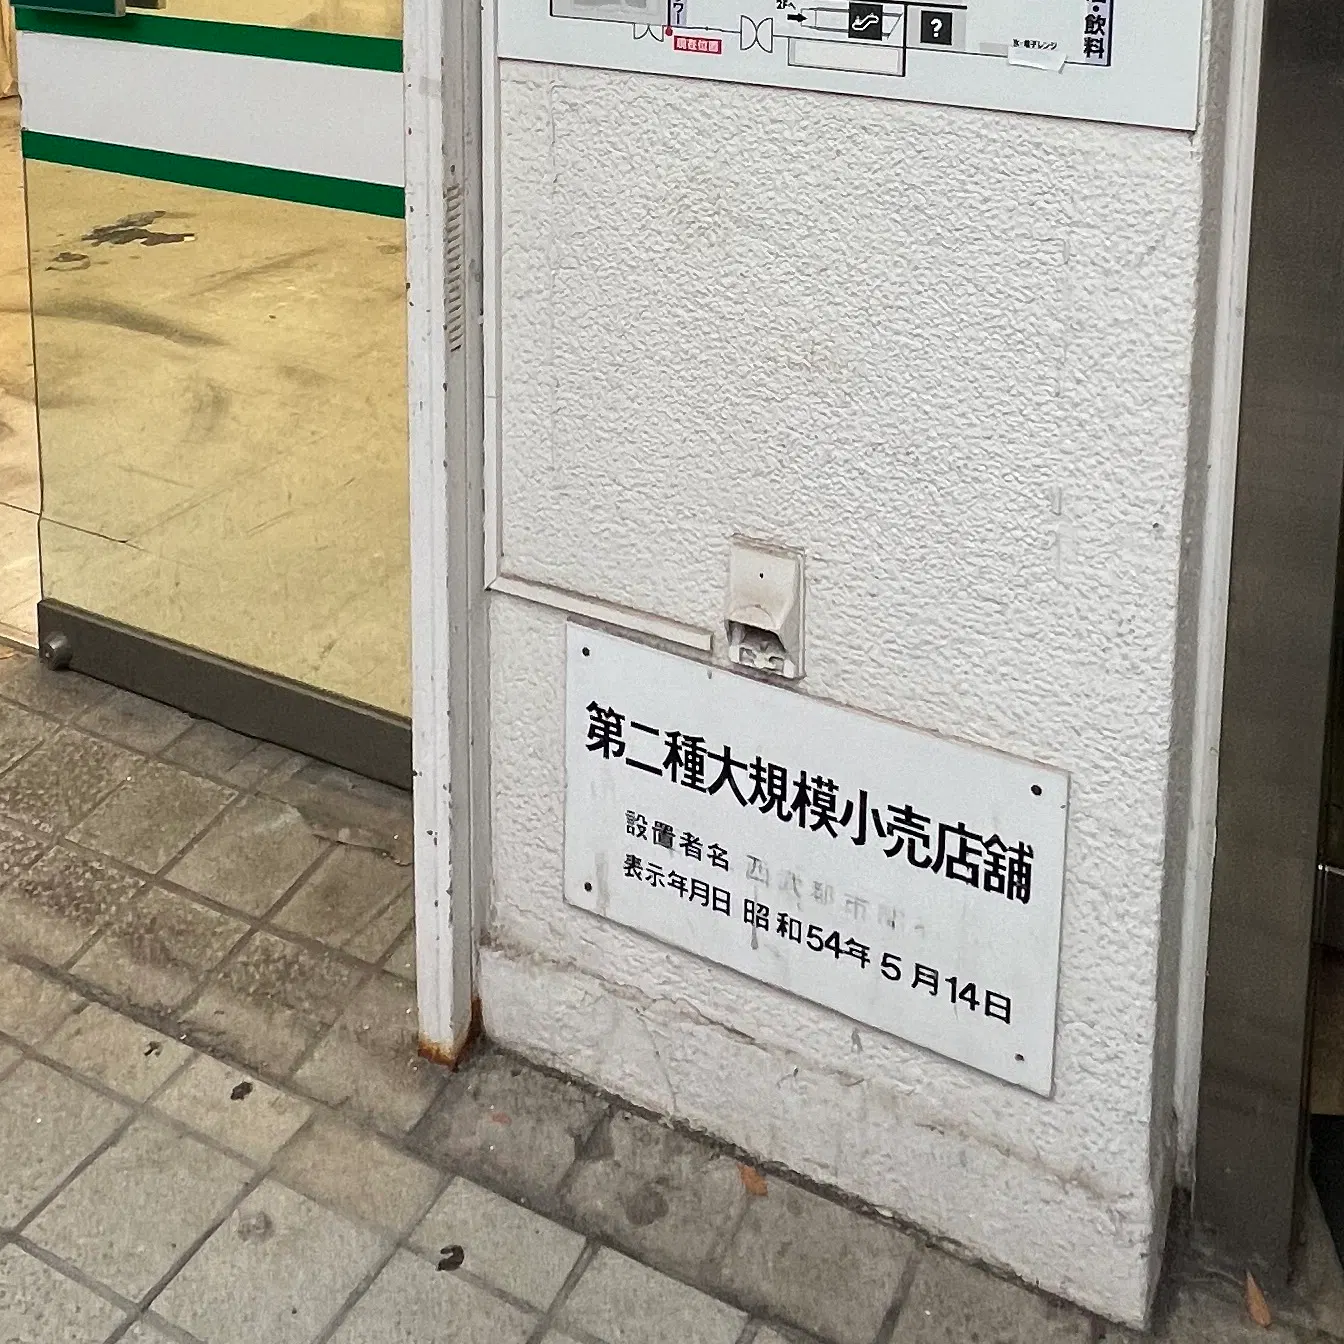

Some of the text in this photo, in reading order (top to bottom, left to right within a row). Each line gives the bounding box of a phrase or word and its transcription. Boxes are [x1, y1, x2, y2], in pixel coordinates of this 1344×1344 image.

[586, 701, 1034, 905] 第二種大規模小売店舗
[625, 809, 731, 873] 設置者名
[622, 852, 733, 918] 表示年月日
